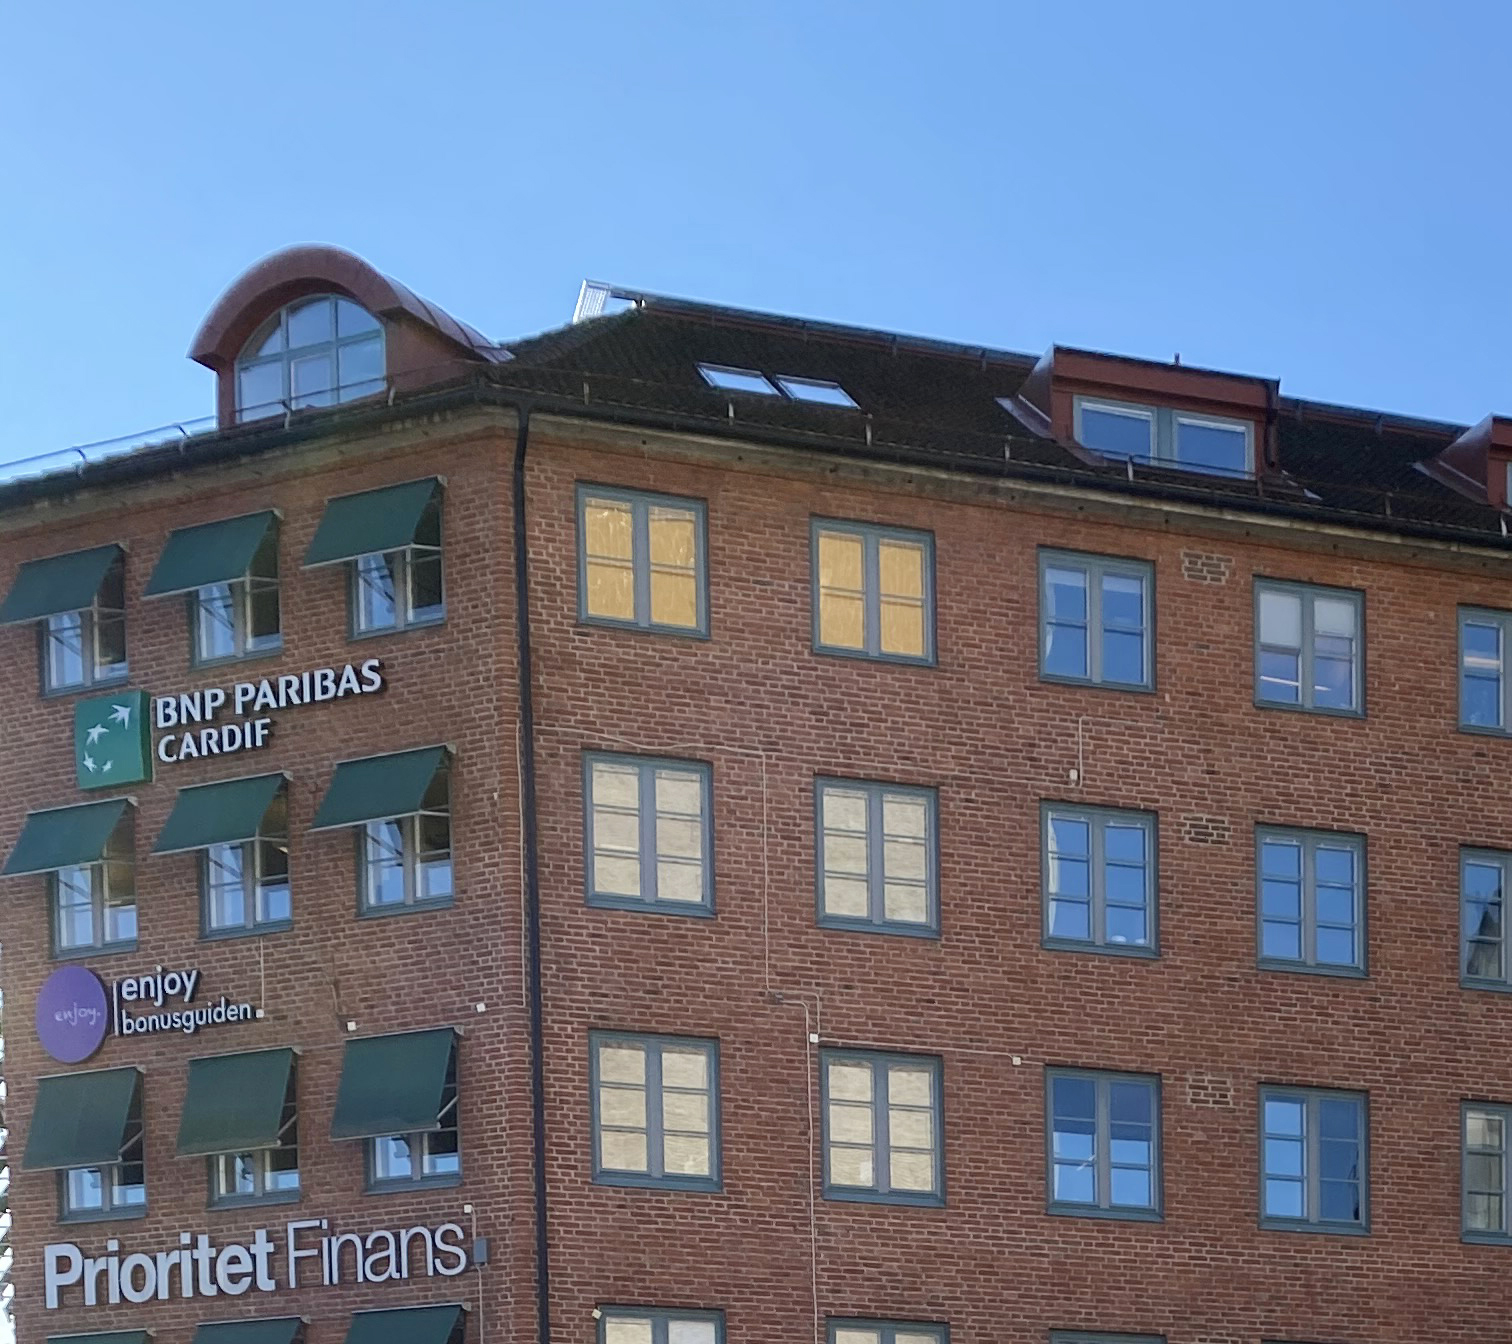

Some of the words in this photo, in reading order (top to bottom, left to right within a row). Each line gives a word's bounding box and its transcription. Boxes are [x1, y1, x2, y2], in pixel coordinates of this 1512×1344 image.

[156, 688, 225, 728] BNP
[234, 658, 383, 715] PARIBAS
[157, 718, 271, 763] CARDIF
[121, 965, 198, 1006] enjoy
[121, 996, 251, 1034] bonusguiden
[43, 1228, 276, 1309] Prioritet
[287, 1218, 467, 1289] Finans
